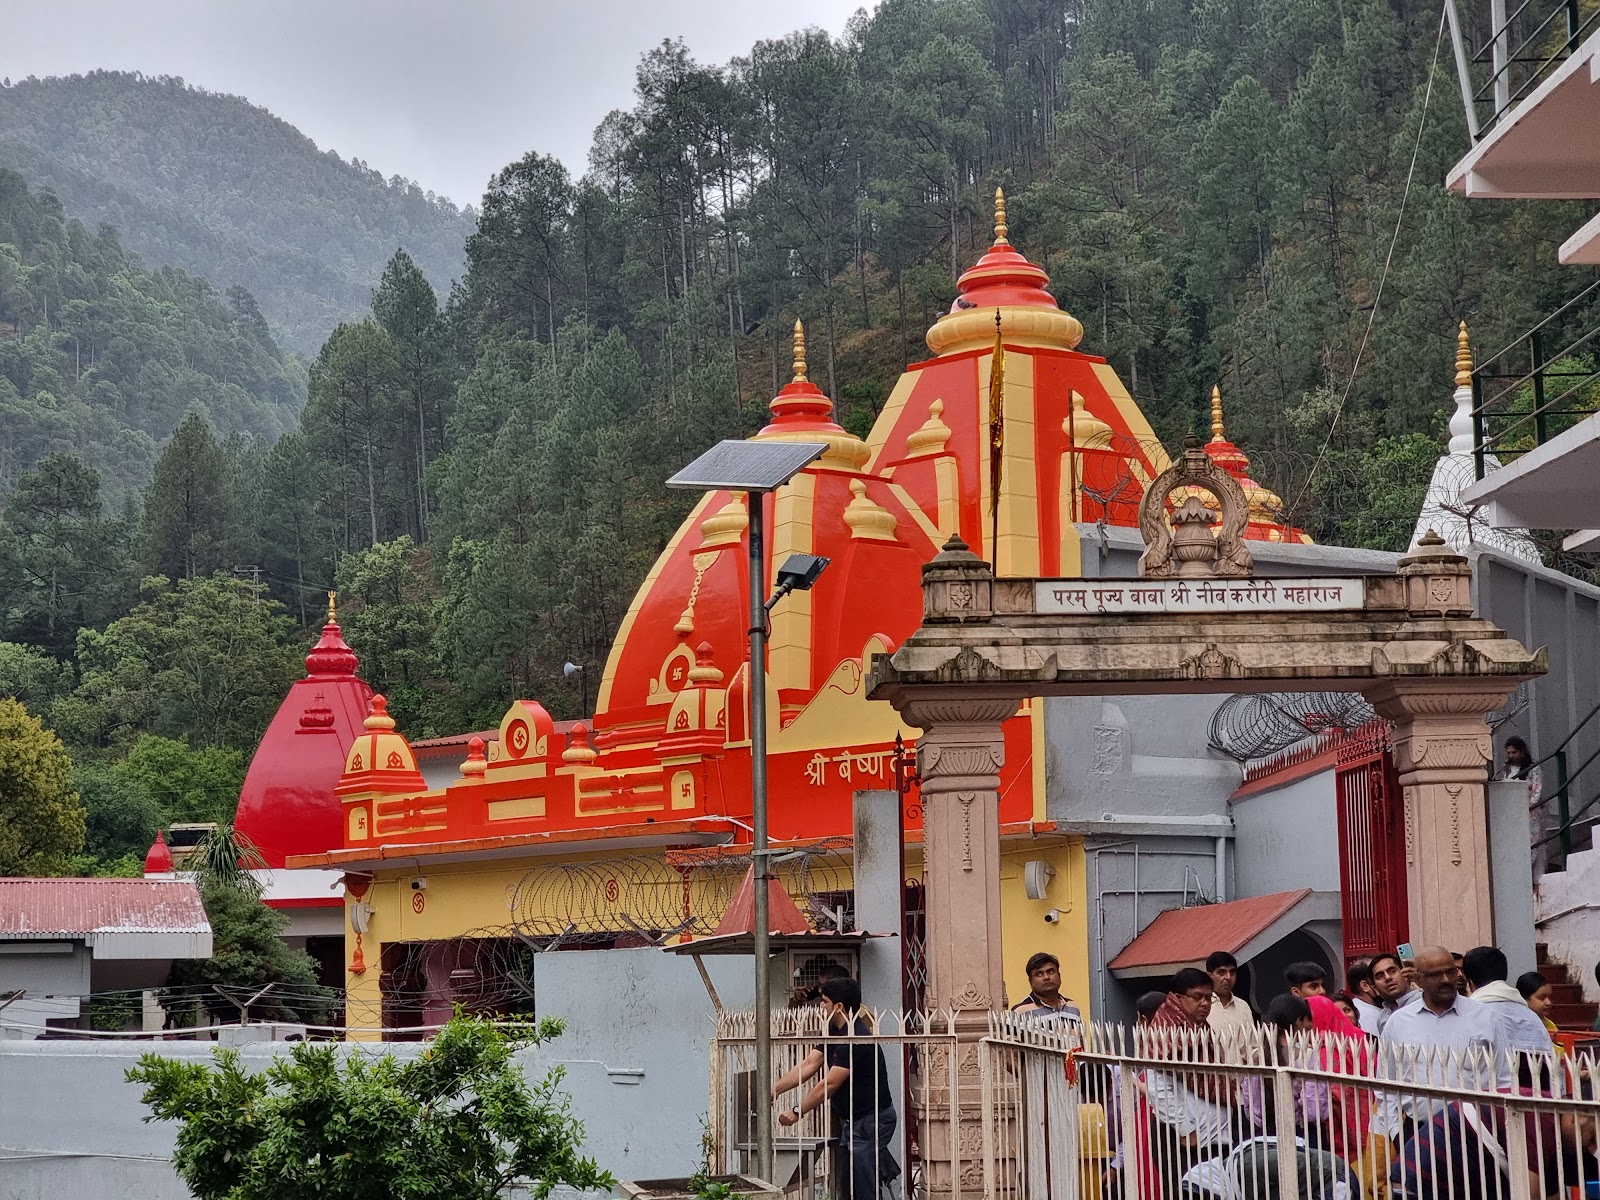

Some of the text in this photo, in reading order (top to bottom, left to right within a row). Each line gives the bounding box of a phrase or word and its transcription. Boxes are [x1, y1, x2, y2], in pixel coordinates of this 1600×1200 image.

[1053, 580, 1342, 612] परम् पूज्य बाबा श्री नीब करौरी महाराज
[803, 752, 830, 786] श्री
